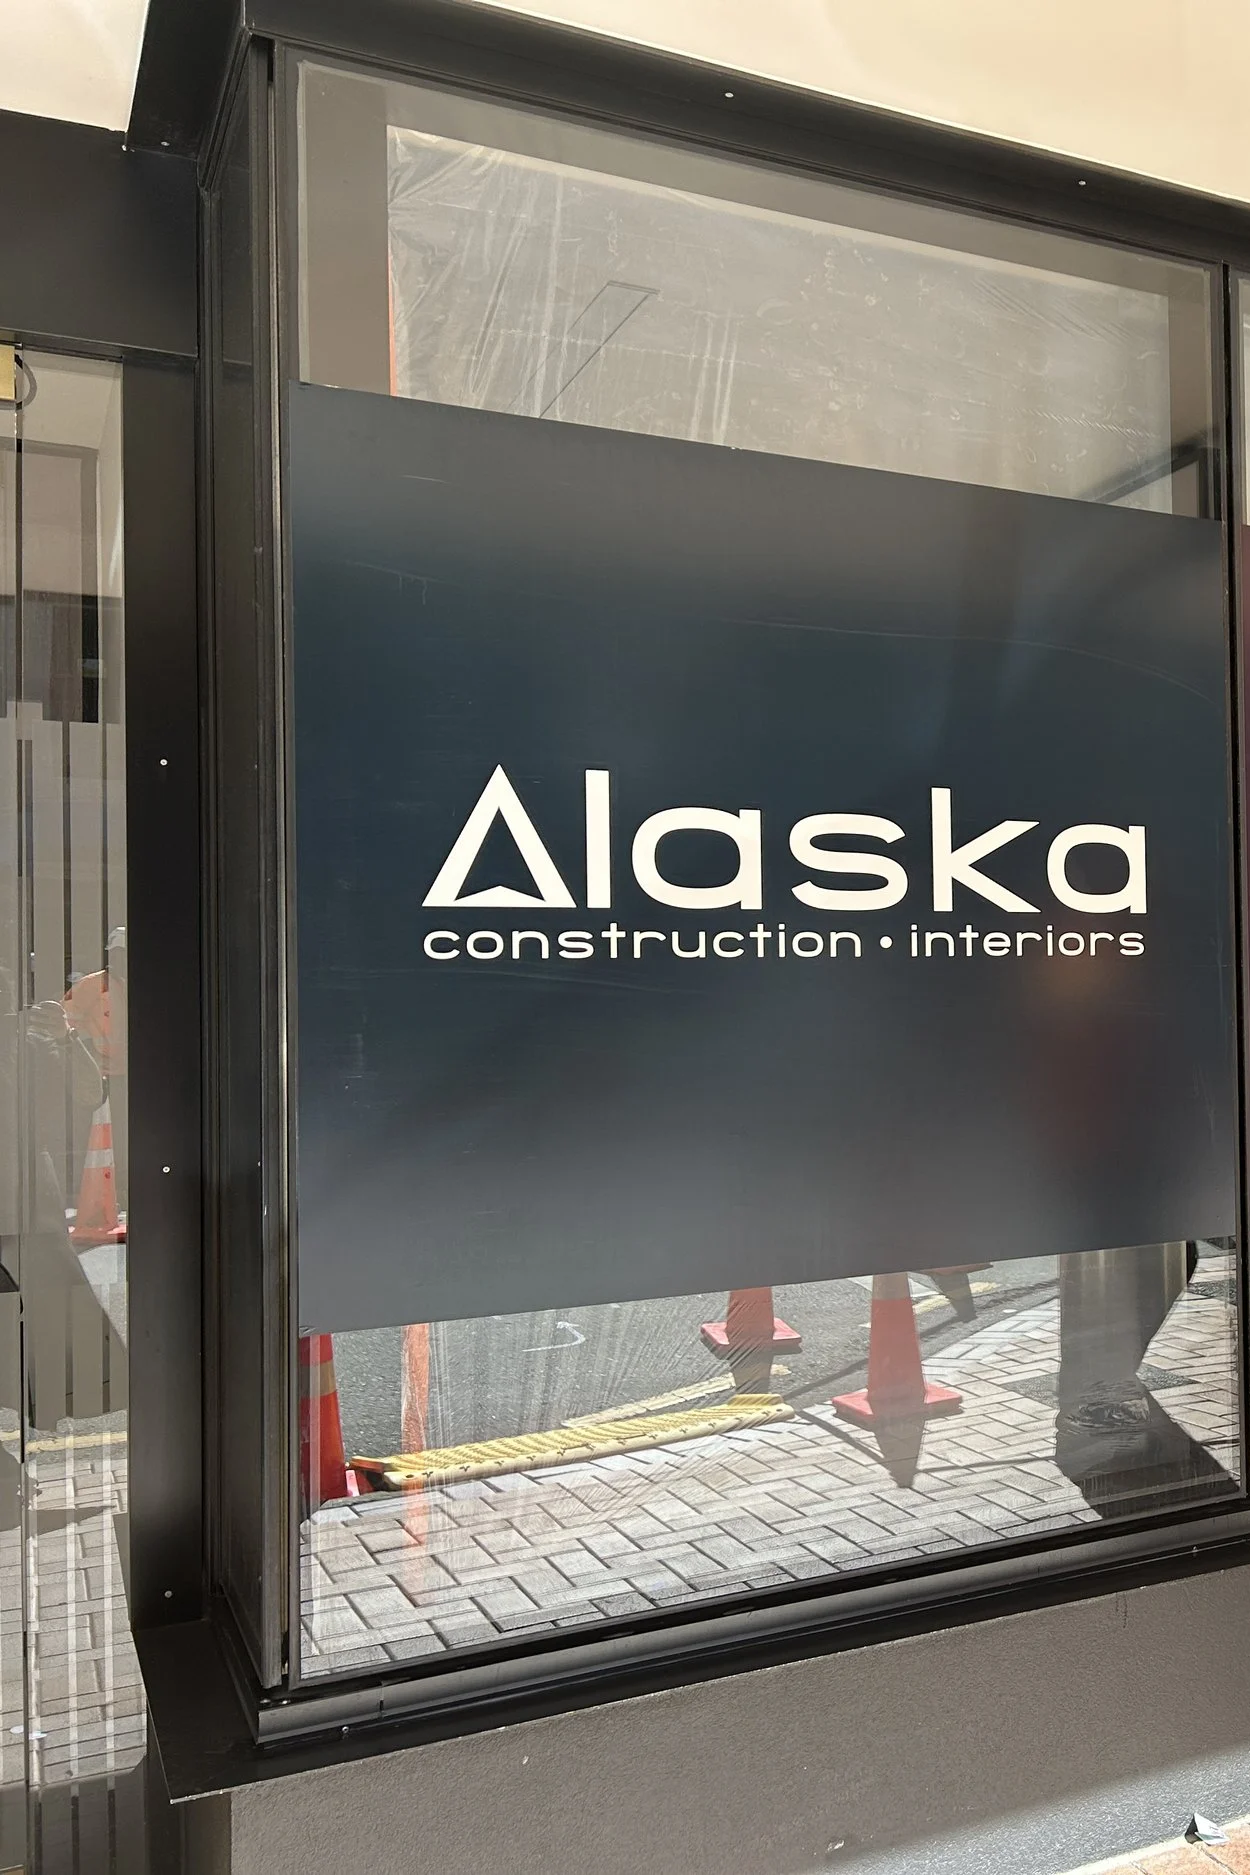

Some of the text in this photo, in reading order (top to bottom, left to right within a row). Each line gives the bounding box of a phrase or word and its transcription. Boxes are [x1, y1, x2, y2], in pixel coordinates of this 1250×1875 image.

[421, 764, 1148, 915] Alaska
[422, 922, 1146, 960] construction interiors
